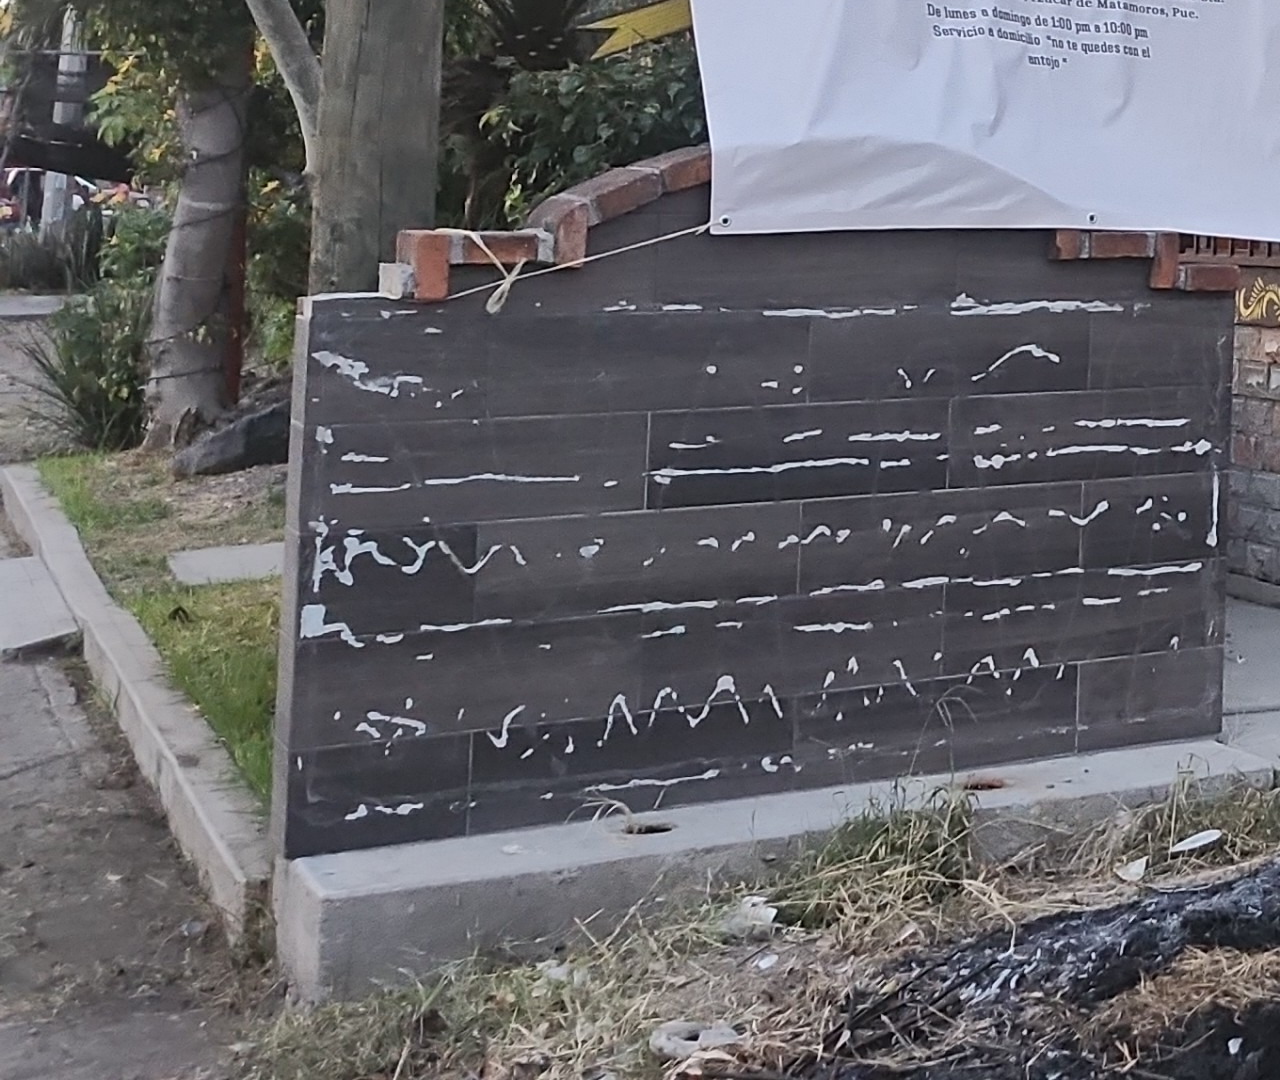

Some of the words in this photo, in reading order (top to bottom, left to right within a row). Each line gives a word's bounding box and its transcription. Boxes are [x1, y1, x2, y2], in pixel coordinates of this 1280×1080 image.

[926, 3, 942, 17] De
[944, 7, 977, 19] lunes
[992, 7, 1032, 26] domingo
[1034, 14, 1049, 27] de
[1051, 16, 1072, 31] 1:00
[1075, 22, 1091, 34] pm
[1103, 22, 1132, 36] 10:00
[1134, 27, 1148, 39] pm
[1097, 0, 1169, 18] Matamoros,
[1172, 7, 1199, 19] Pue.
[933, 25, 985, 39] Servicio
[997, 28, 1041, 46] domicilio
[1066, 39, 1078, 51] te
[1081, 40, 1121, 54] quedes
[1123, 45, 1139, 57] con
[1142, 47, 1151, 59] el
